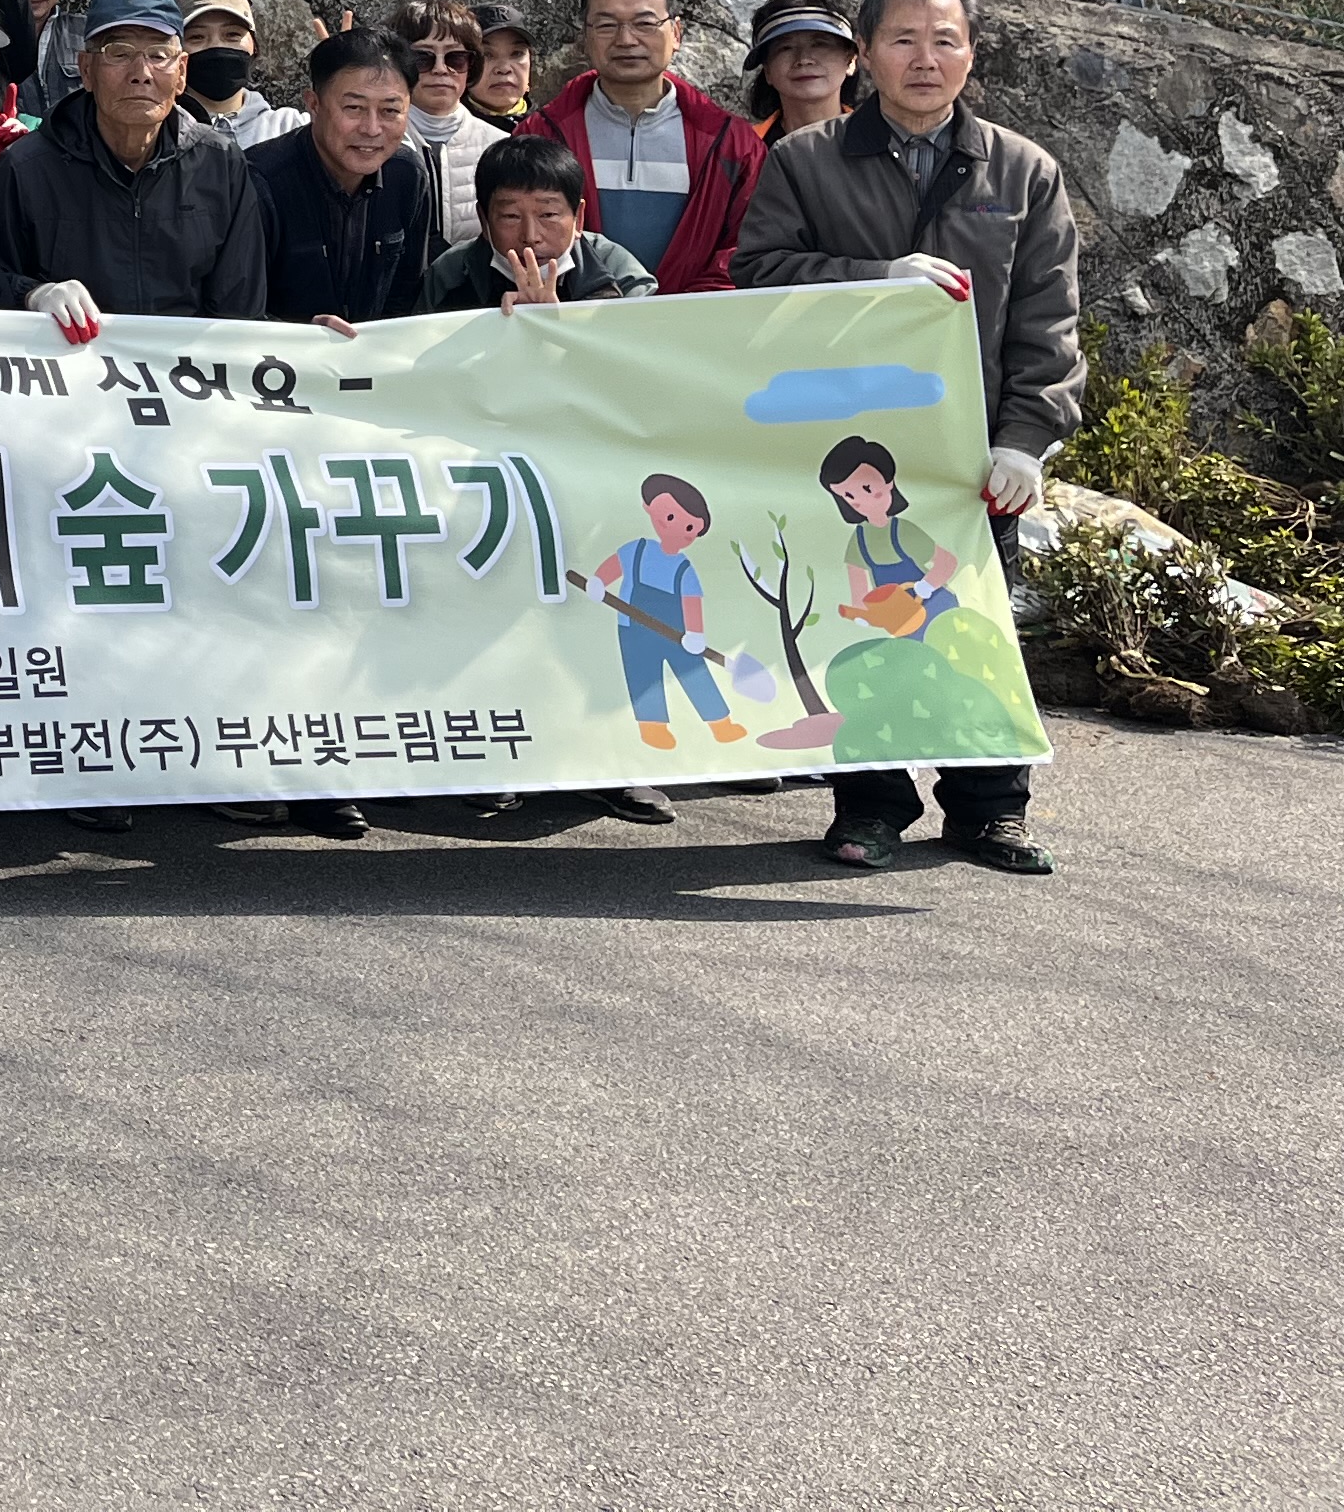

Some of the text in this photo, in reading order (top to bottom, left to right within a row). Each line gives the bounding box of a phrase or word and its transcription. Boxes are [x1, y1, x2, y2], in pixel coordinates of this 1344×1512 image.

[97, 355, 313, 426] 심어요
[56, 452, 168, 605] 숲
[214, 454, 561, 603] 가꾸기
[215, 708, 533, 768] 부산빛드림본부
